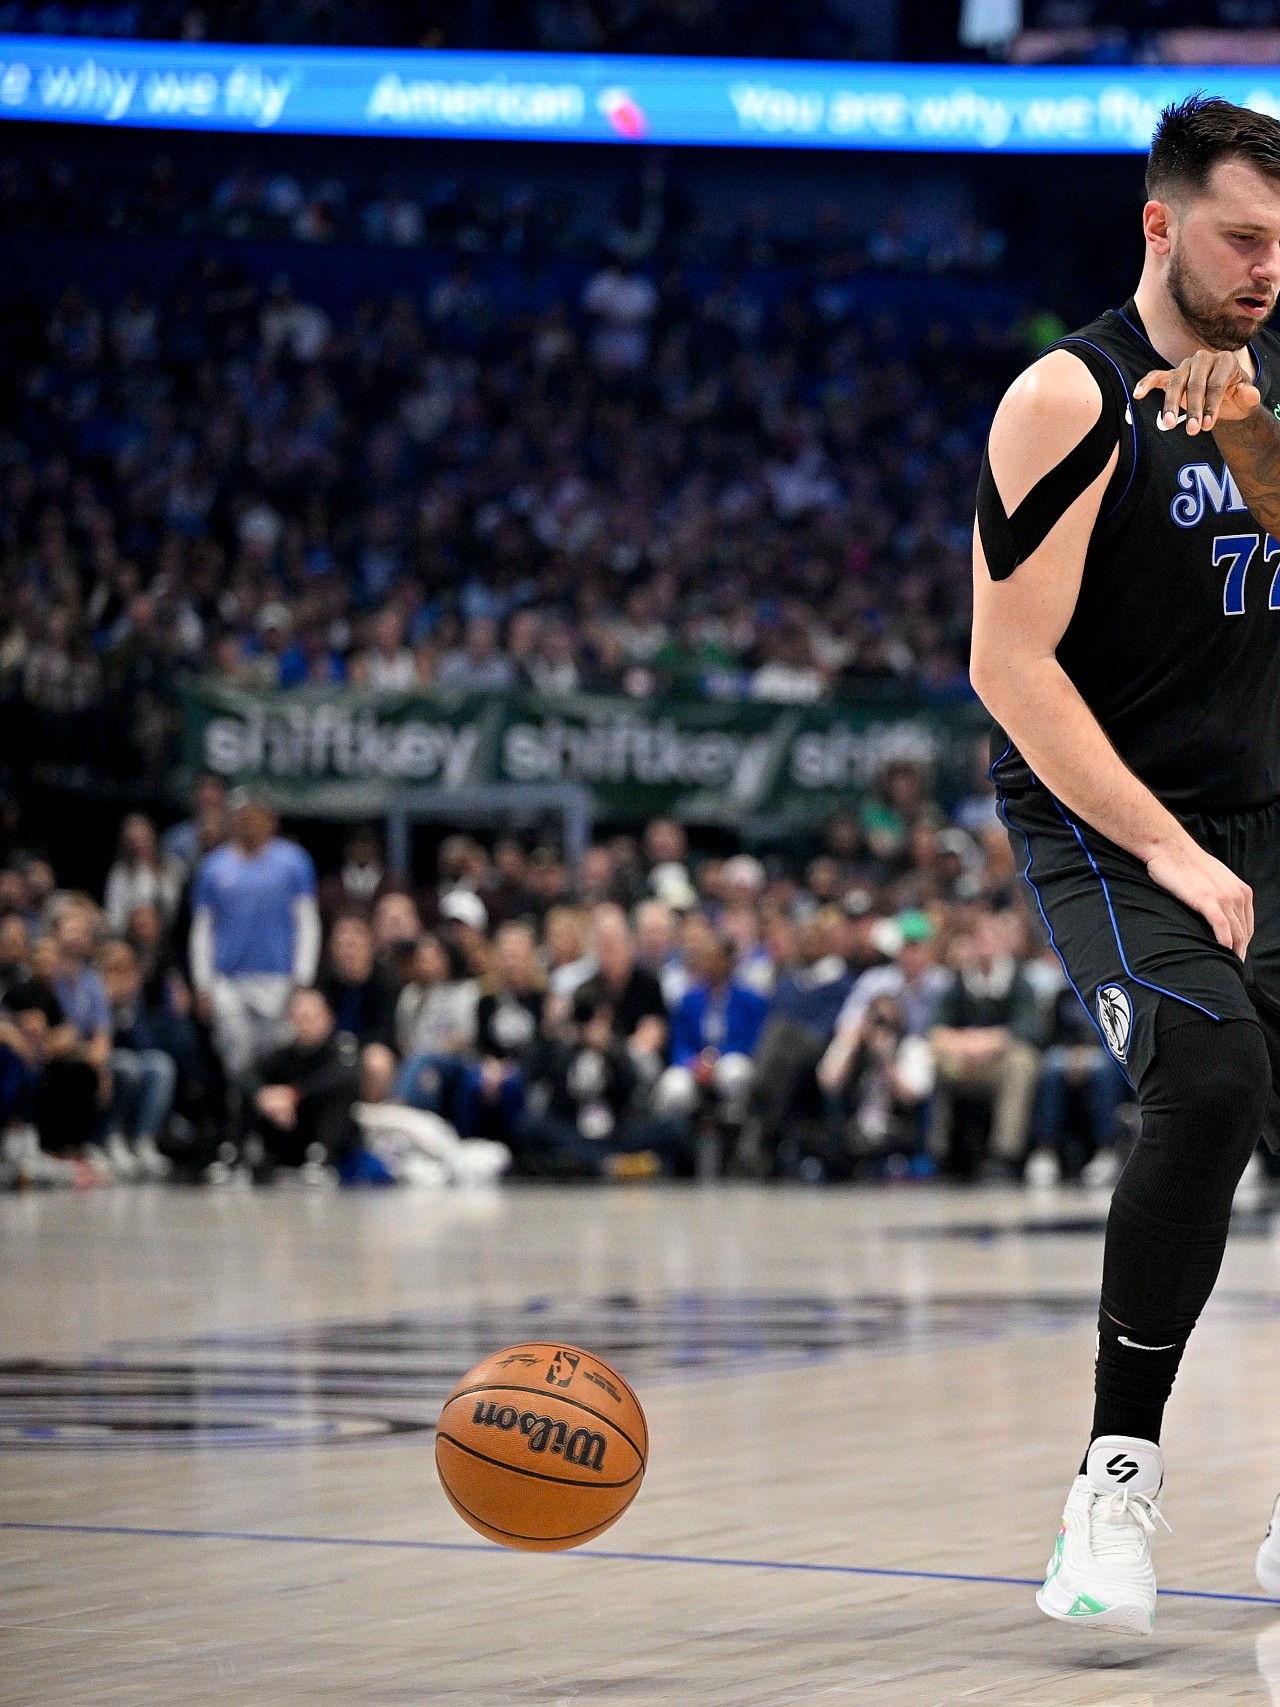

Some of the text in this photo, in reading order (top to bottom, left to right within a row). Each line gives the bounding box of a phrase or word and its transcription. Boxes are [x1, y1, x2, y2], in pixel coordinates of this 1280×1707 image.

[40, 58, 138, 121] why
[144, 69, 219, 116] we
[222, 63, 298, 128] fly
[366, 71, 585, 127] American
[729, 81, 825, 133] You
[912, 87, 1010, 148] why
[1020, 97, 1096, 139] we
[471, 1398, 609, 1473] Wilson
